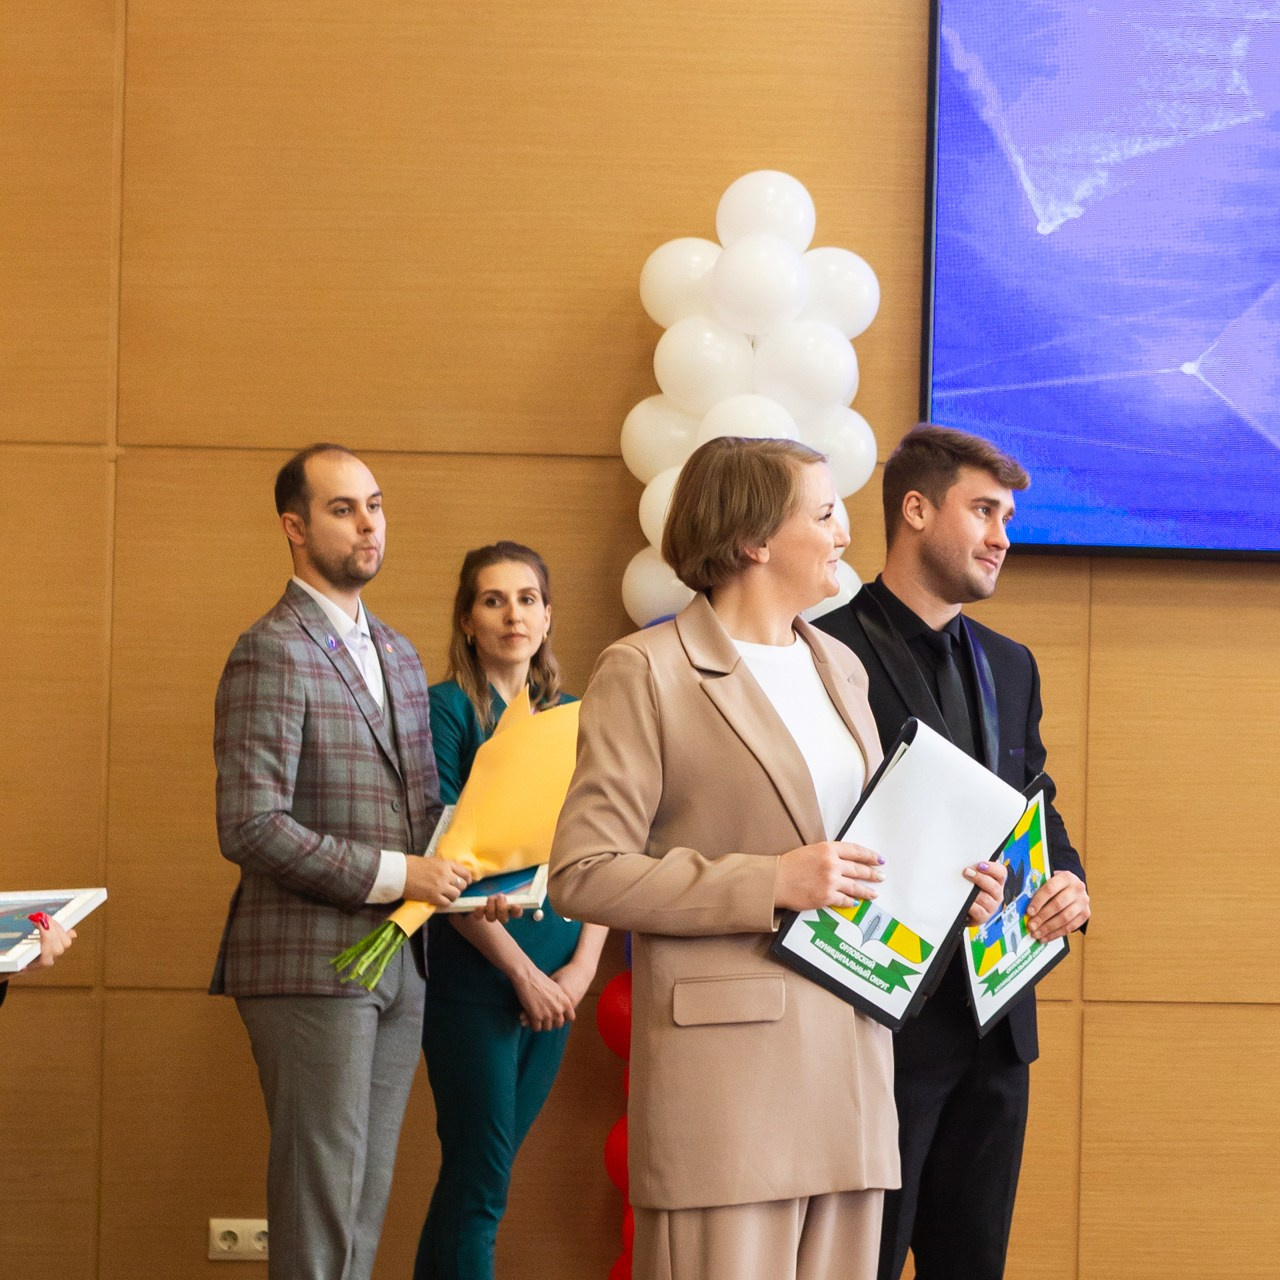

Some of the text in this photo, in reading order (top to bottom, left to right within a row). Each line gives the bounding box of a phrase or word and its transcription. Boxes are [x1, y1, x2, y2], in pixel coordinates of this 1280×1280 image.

[814, 938, 890, 990] МУНИЦИПАЛЬНЫЙ ОКРУГ
[839, 941, 876, 969] ОРЛОВСКИЙ
